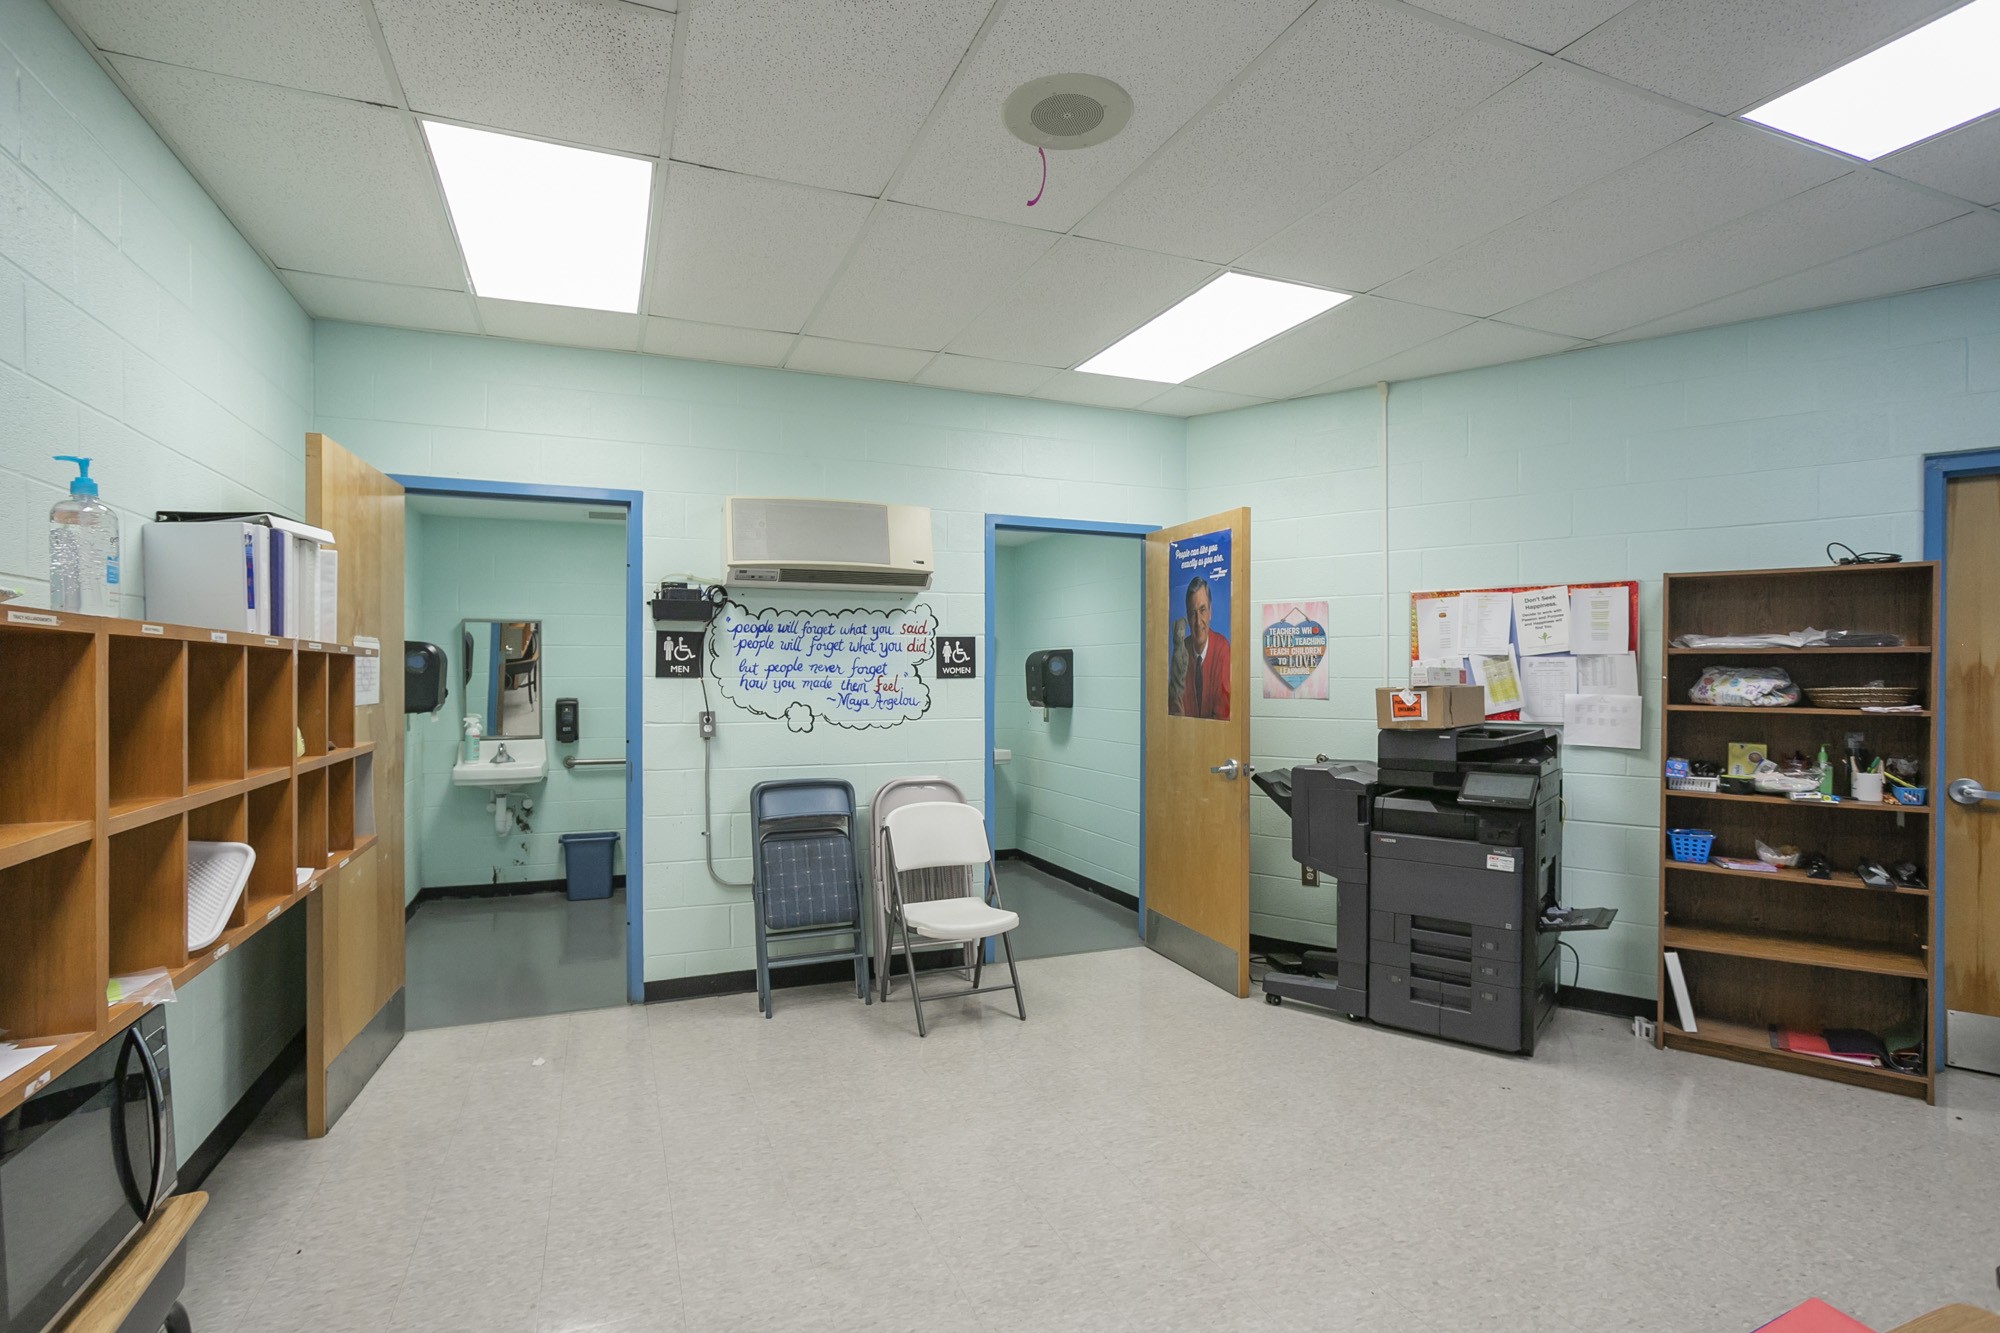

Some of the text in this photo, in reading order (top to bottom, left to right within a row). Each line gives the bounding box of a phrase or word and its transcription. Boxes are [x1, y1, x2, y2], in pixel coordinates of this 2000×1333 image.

[1175, 544, 1218, 559] People can like you
[1181, 558, 1198, 569] exactly
[1203, 556, 1213, 567] you
[778, 621, 799, 633] will
[800, 621, 836, 641] forget
[840, 621, 867, 634] what
[873, 623, 894, 641] you
[1269, 627, 1300, 636] TEACHERS
[734, 636, 774, 656] people
[780, 637, 802, 652] will
[806, 637, 844, 657] forget
[849, 637, 875, 653] what
[879, 641, 902, 657] you
[1265, 635, 1326, 648] LOVE TEACHING
[1269, 646, 1322, 656] TEACH CHILDREN
[1278, 655, 1317, 668] TO LOVE
[739, 657, 887, 682] but people never forget
[942, 666, 971, 674] WOMEN
[739, 676, 767, 691] how
[773, 679, 796, 693] you
[802, 678, 833, 690] made
[841, 679, 868, 692] them
[872, 692, 920, 711] Angelou
